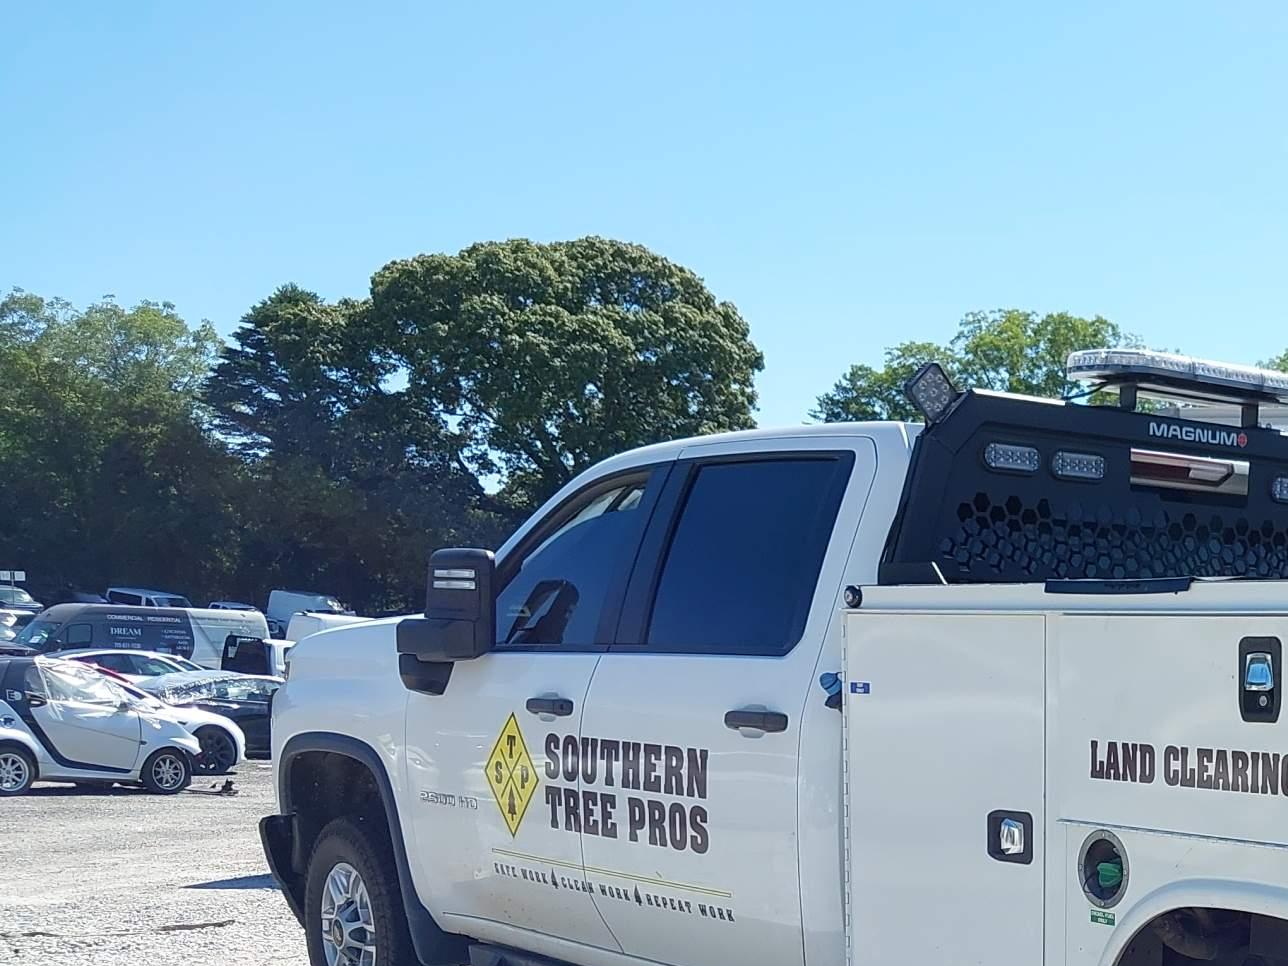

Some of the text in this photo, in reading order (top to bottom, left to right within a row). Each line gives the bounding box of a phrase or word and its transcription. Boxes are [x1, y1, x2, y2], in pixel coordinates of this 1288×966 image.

[1149, 422, 1237, 446] MAGNUM
[110, 627, 142, 636] DREAM
[506, 735, 517, 759] T
[1090, 740, 1155, 784] LAND
[494, 760, 529, 789] S P
[545, 733, 709, 799] SOUTHERN
[545, 785, 710, 854] TREE PROS
[494, 862, 736, 922] SAFE WORK CLEAN WORK REPEAT WORK
